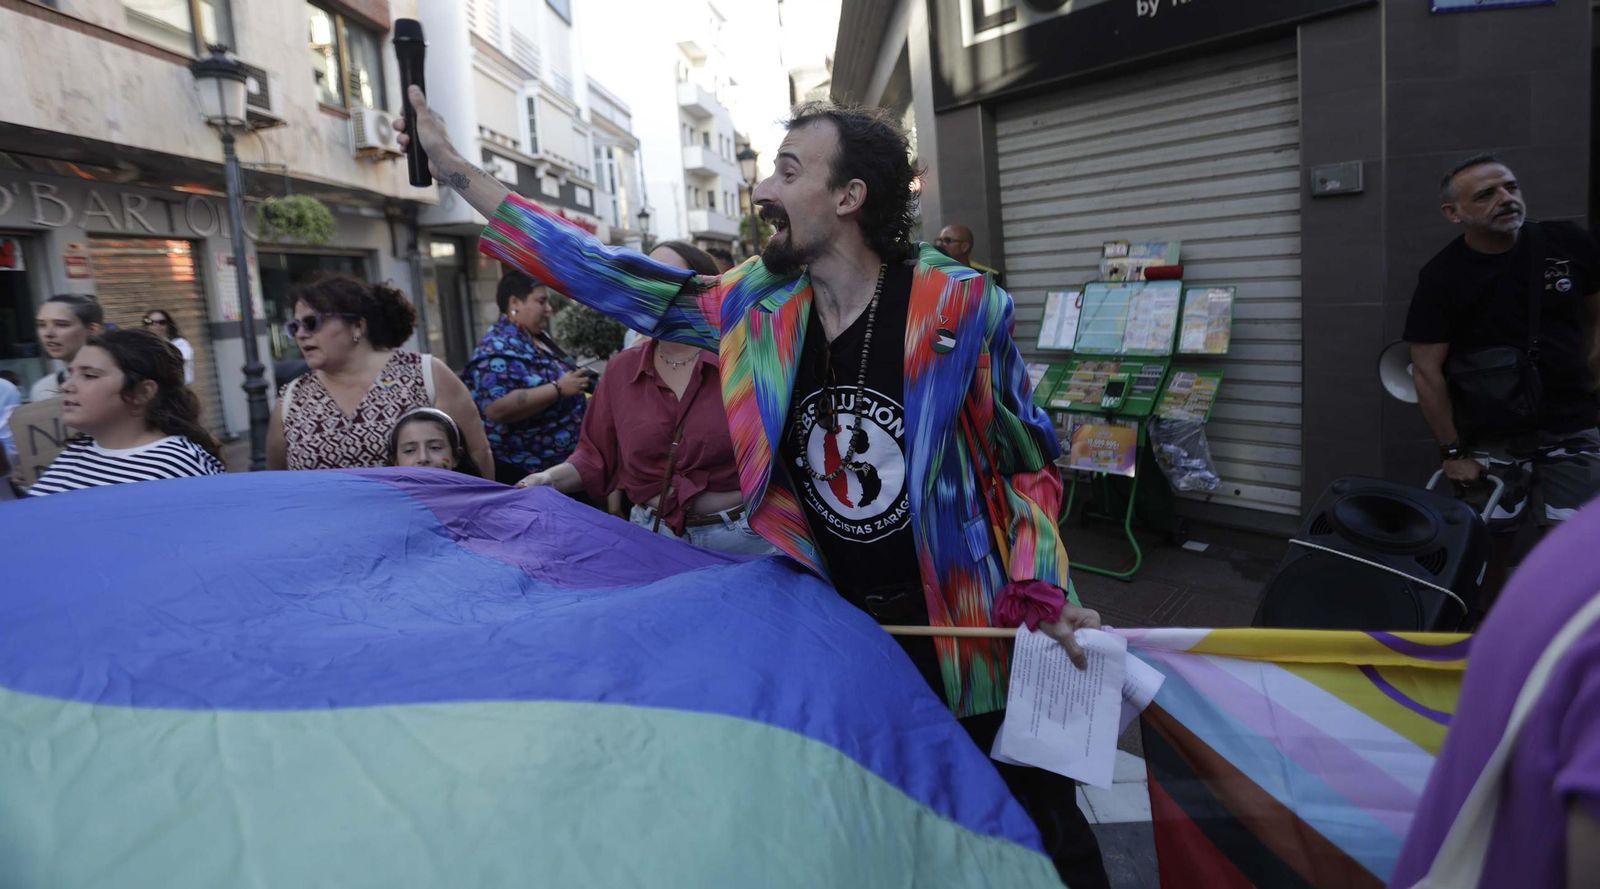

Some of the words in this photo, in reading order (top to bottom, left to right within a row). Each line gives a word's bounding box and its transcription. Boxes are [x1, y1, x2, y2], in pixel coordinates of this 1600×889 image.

[1136, 0, 1160, 18] by
[803, 481, 873, 535] ANTIFASCISTAS
[874, 492, 910, 530] ZARAG
